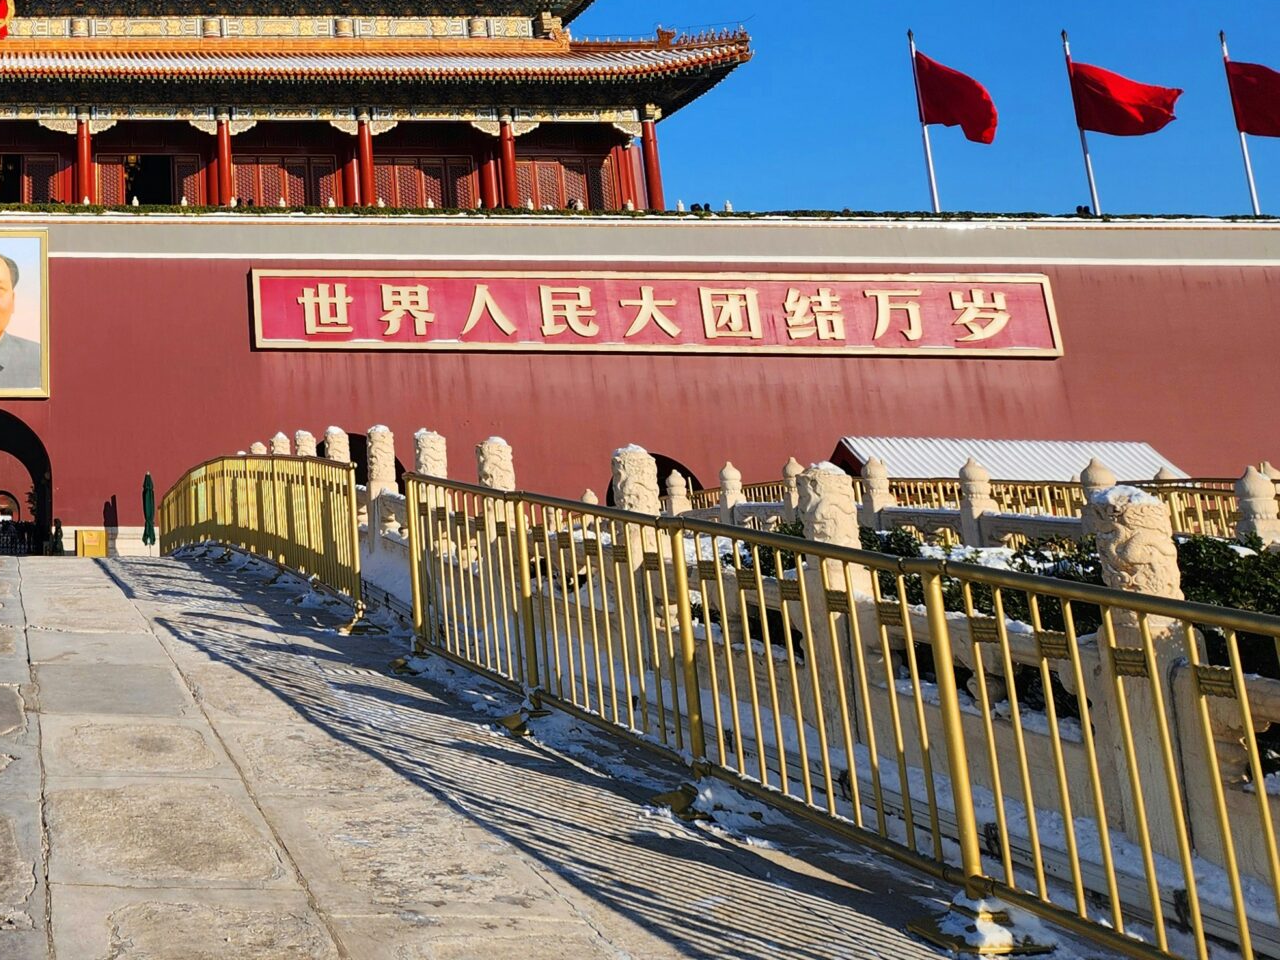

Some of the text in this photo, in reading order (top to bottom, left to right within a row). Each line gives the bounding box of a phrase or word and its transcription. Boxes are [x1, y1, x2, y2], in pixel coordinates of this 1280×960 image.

[297, 282, 1011, 342] 世界人民大团结万岁
